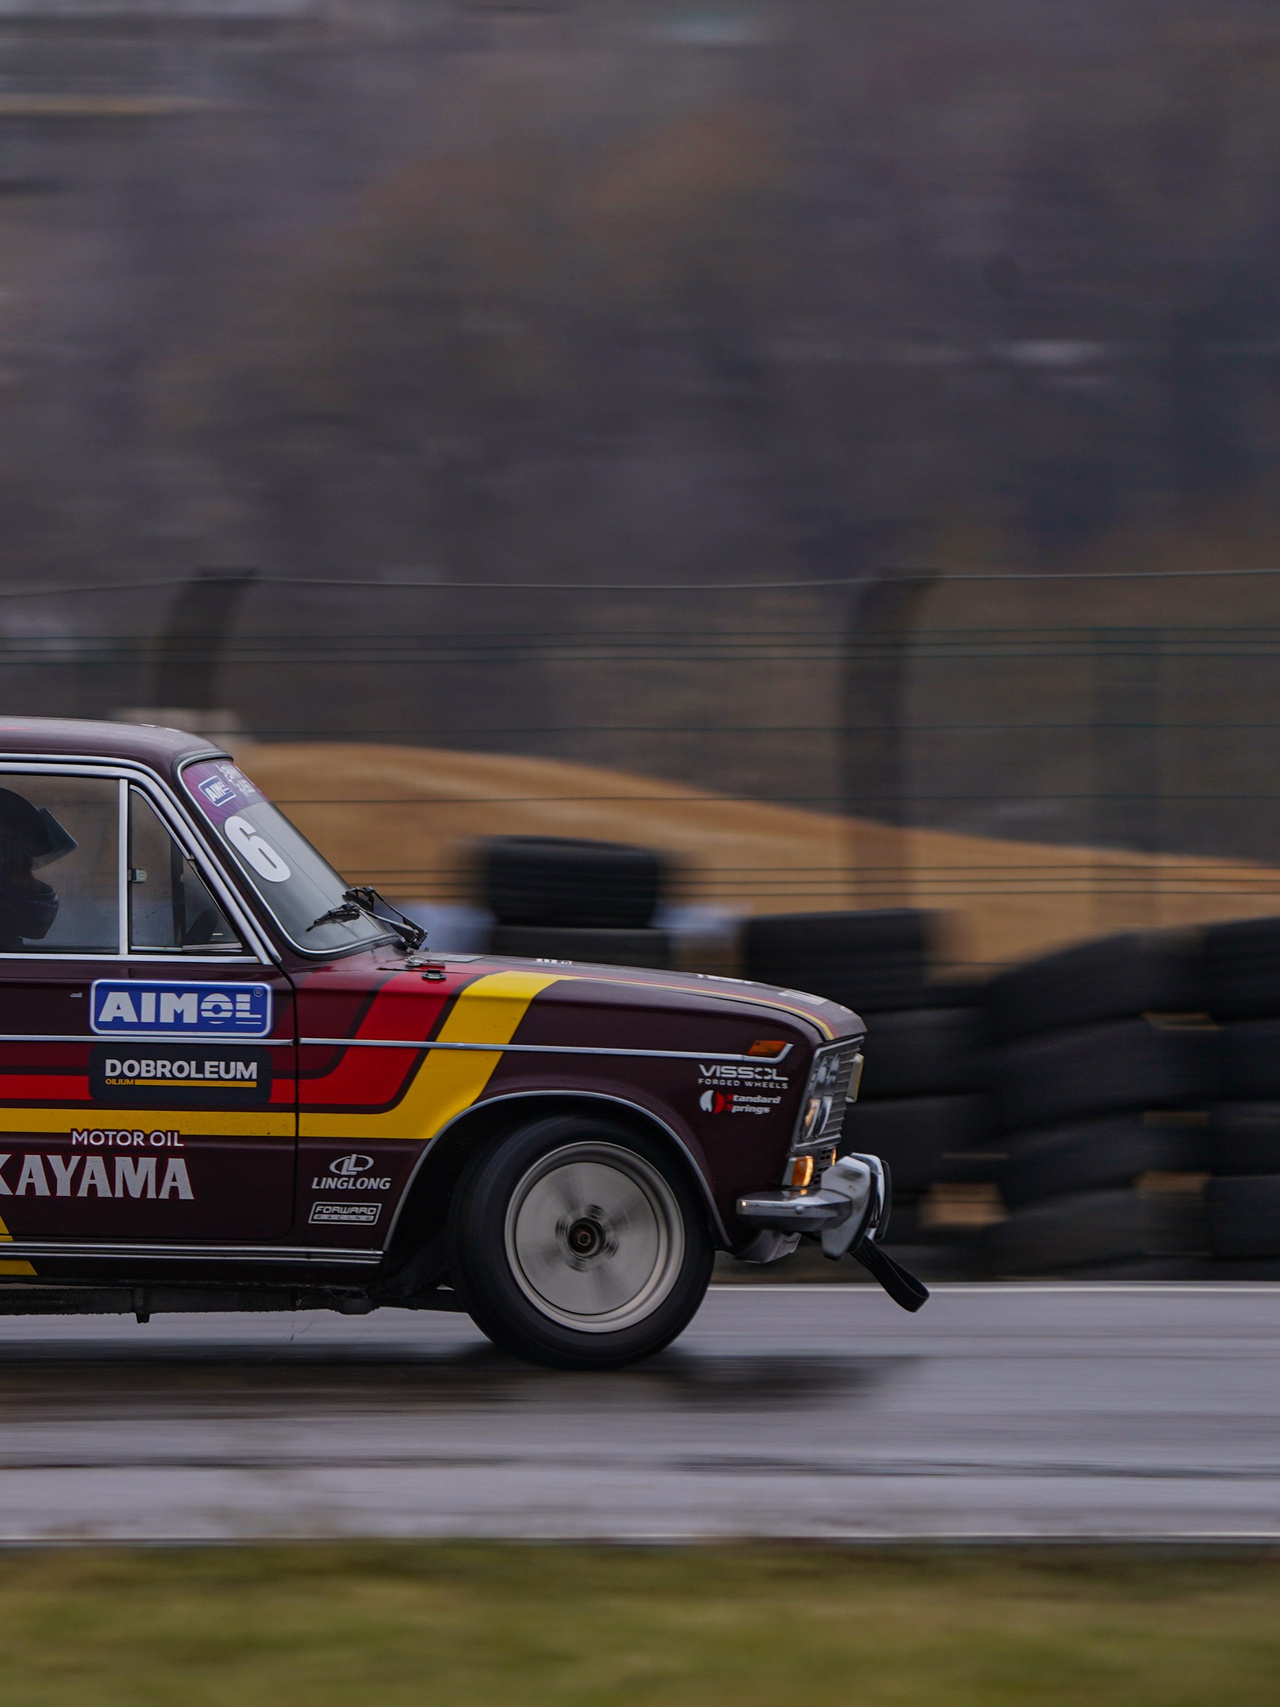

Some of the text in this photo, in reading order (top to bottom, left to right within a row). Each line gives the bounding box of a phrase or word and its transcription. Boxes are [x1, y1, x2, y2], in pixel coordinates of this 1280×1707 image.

[224, 815, 291, 883] 6
[98, 991, 263, 1025] AIMOL
[105, 1059, 258, 1080] DOBROLEUM
[699, 1064, 789, 1081] VISSOL
[698, 1078, 789, 1090] FORGED WHEELS
[726, 1093, 782, 1104] Standard
[72, 1130, 184, 1147] MOTOR OIL
[312, 1178, 391, 1190] LINGLONG
[315, 1207, 376, 1215] FORWARD
